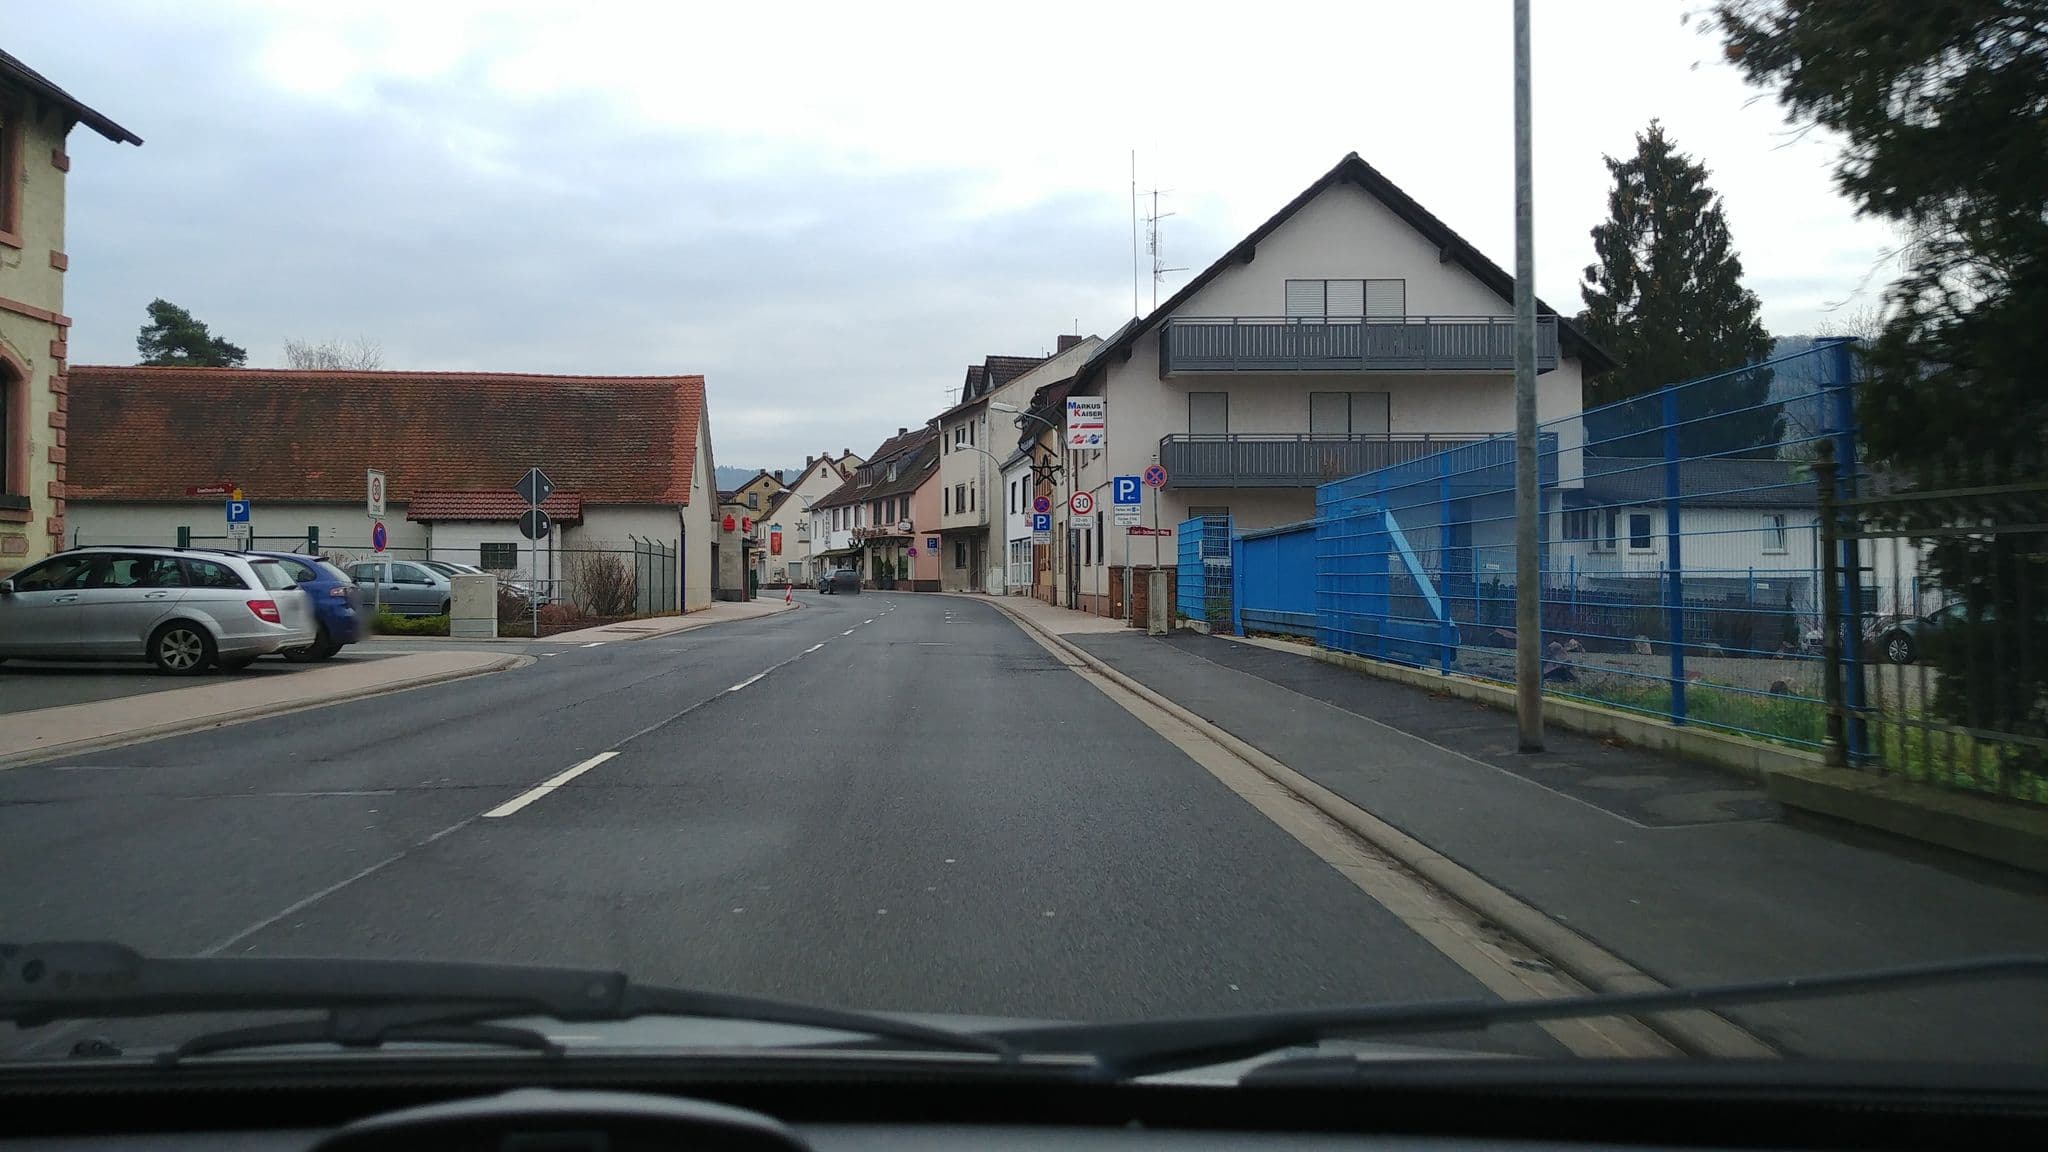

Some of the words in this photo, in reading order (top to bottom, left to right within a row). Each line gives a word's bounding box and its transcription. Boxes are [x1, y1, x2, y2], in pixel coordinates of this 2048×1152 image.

[1120, 480, 1135, 501] P
[1075, 497, 1089, 509] 30
[231, 503, 244, 520] P
[1037, 516, 1047, 529] P
